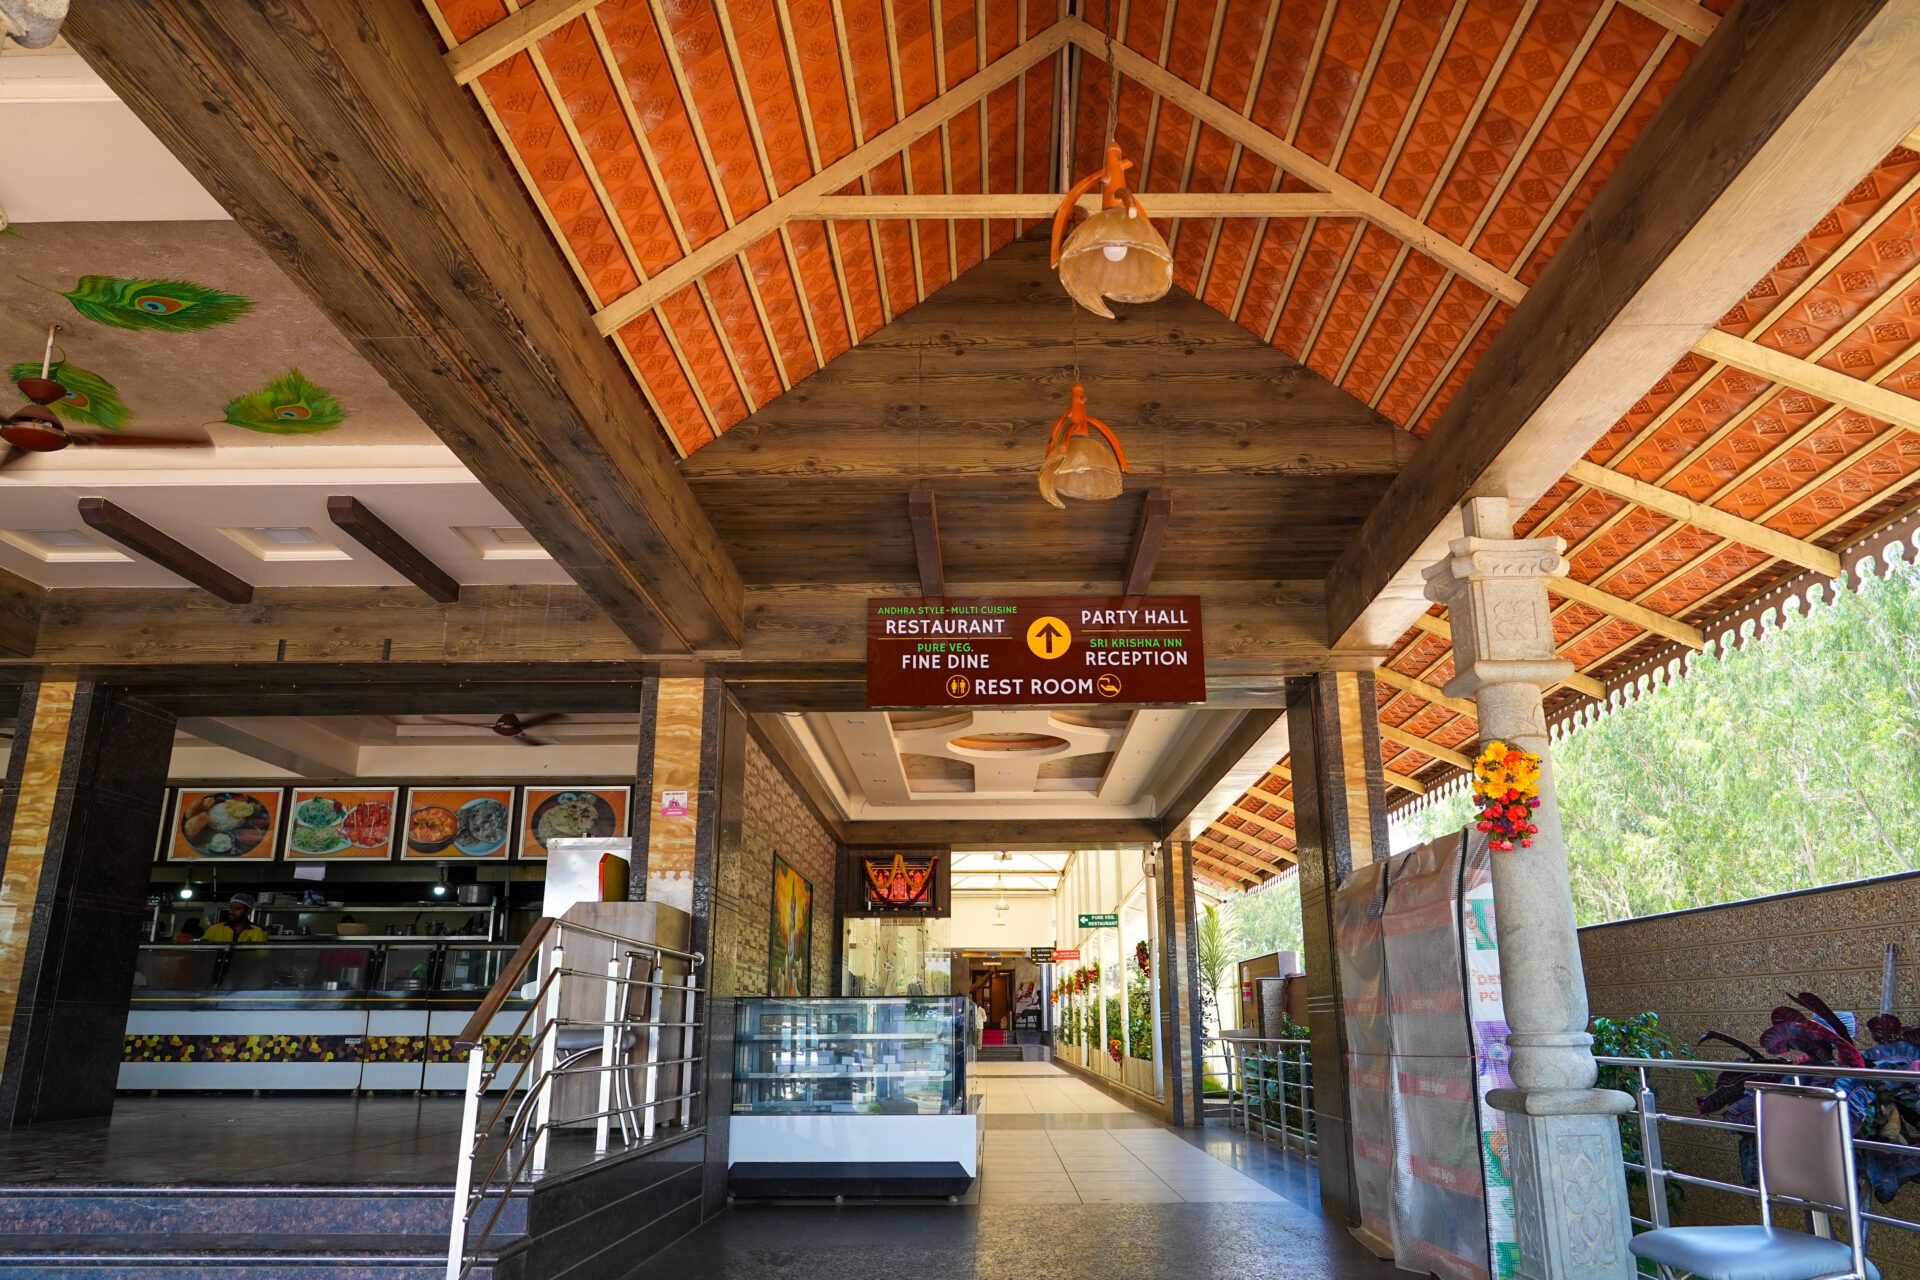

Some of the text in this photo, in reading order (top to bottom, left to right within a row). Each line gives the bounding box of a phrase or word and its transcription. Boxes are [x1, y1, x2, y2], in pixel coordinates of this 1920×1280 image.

[878, 606, 915, 615] ANDHRA
[981, 606, 1018, 614] CUISINE
[1081, 609, 1189, 625] PARTY HALL
[886, 619, 1006, 634] RESTAURANT
[917, 642, 974, 652] PURE VEG.
[1089, 638, 1183, 648] SRI KRISHNA INN
[902, 653, 990, 669] FINE DINE
[1085, 650, 1188, 666] RECEPTION
[975, 678, 1093, 695] REST ROOM
